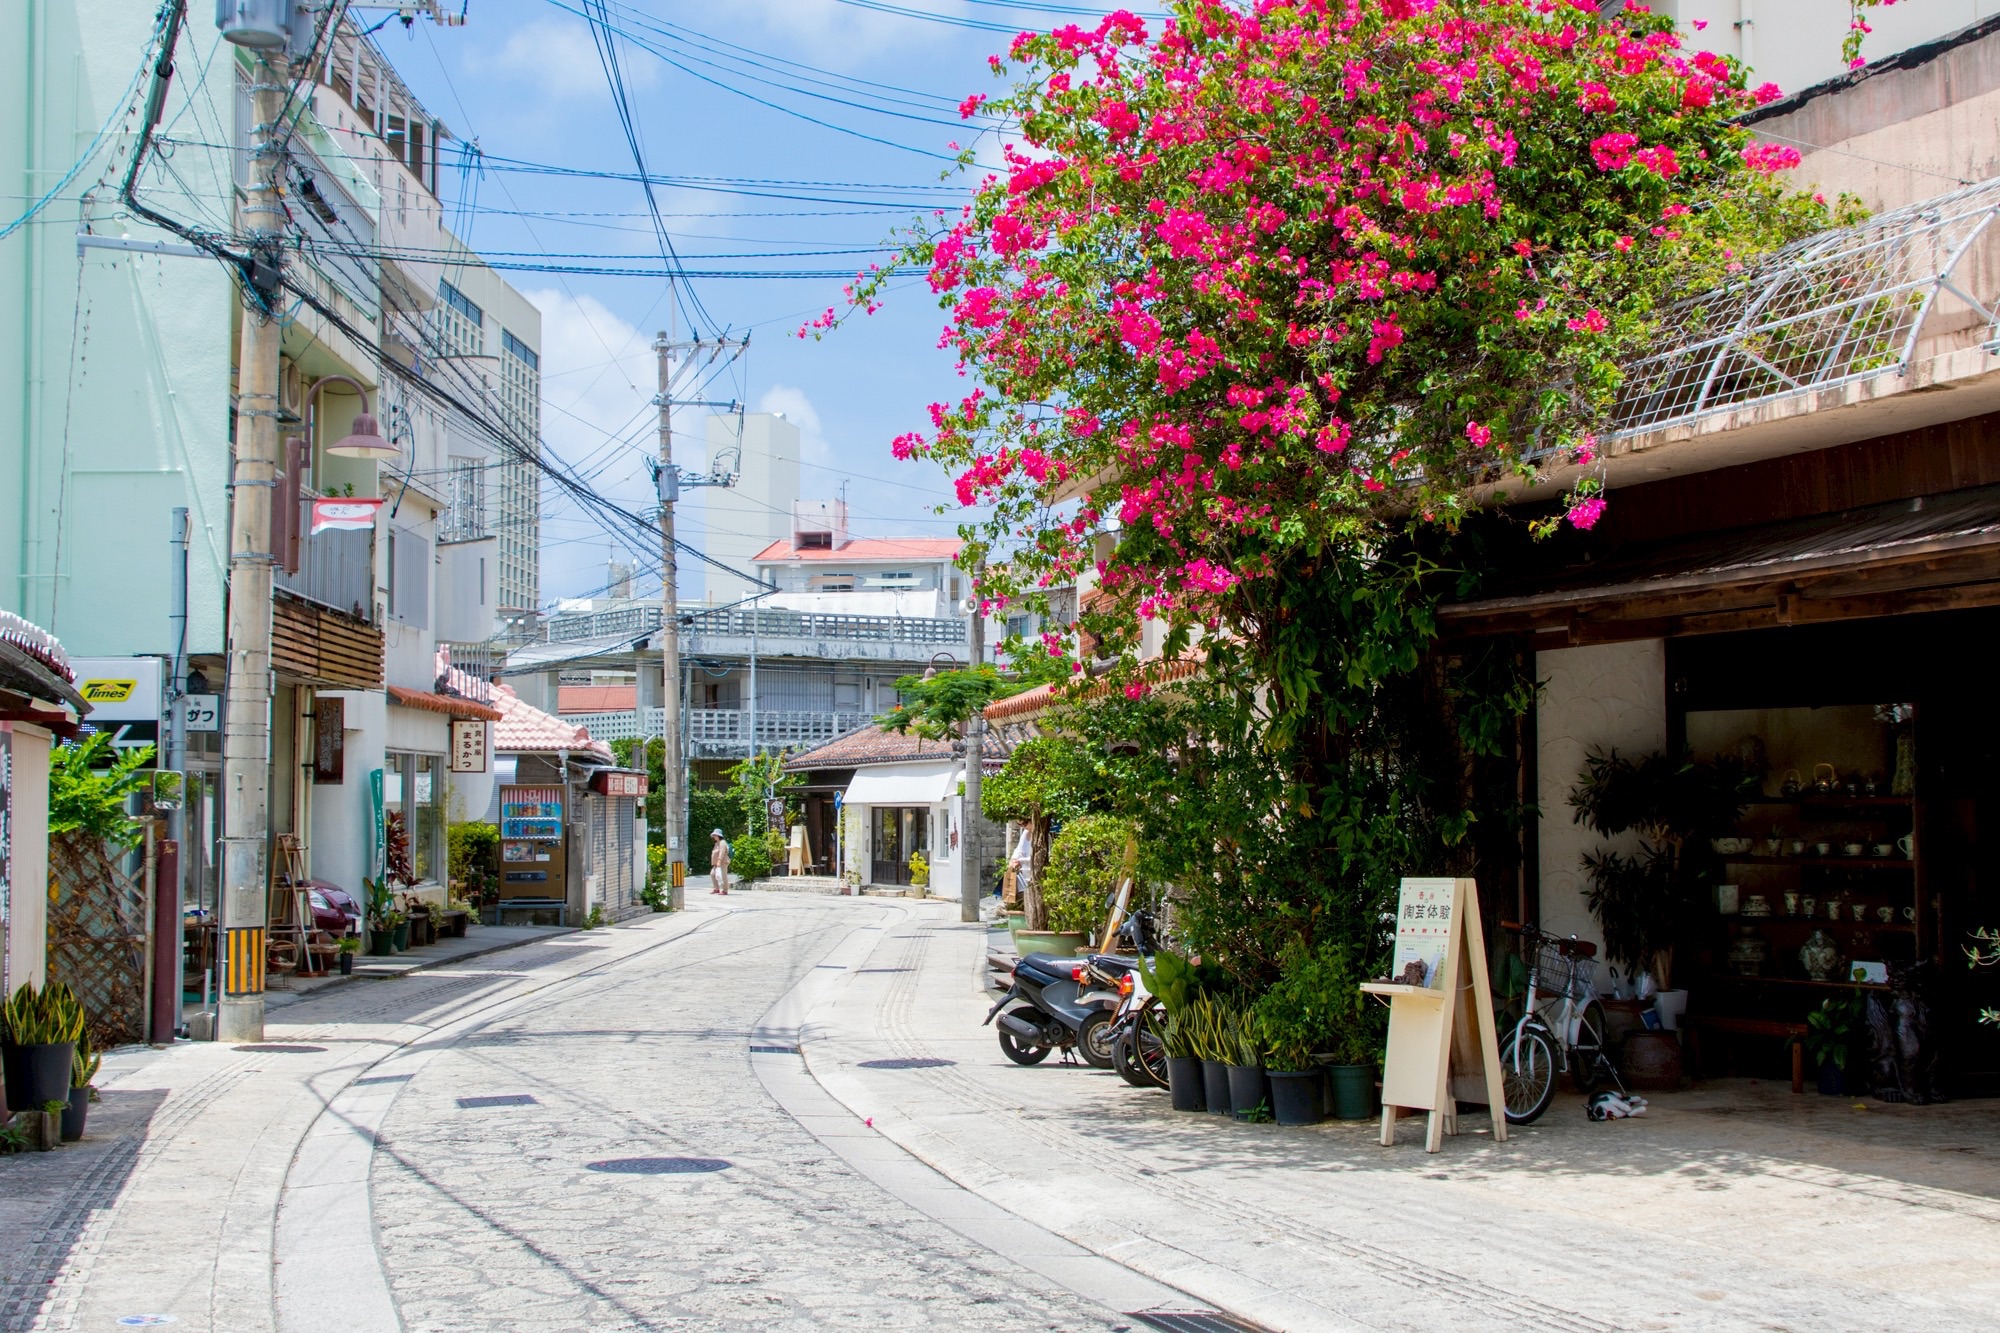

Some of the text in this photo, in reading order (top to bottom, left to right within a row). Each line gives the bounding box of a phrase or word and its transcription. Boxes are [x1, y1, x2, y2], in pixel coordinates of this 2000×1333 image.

[85, 684, 131, 698] Times
[462, 732, 473, 768] まるかつ
[1403, 904, 1451, 919] 陶芸体験
